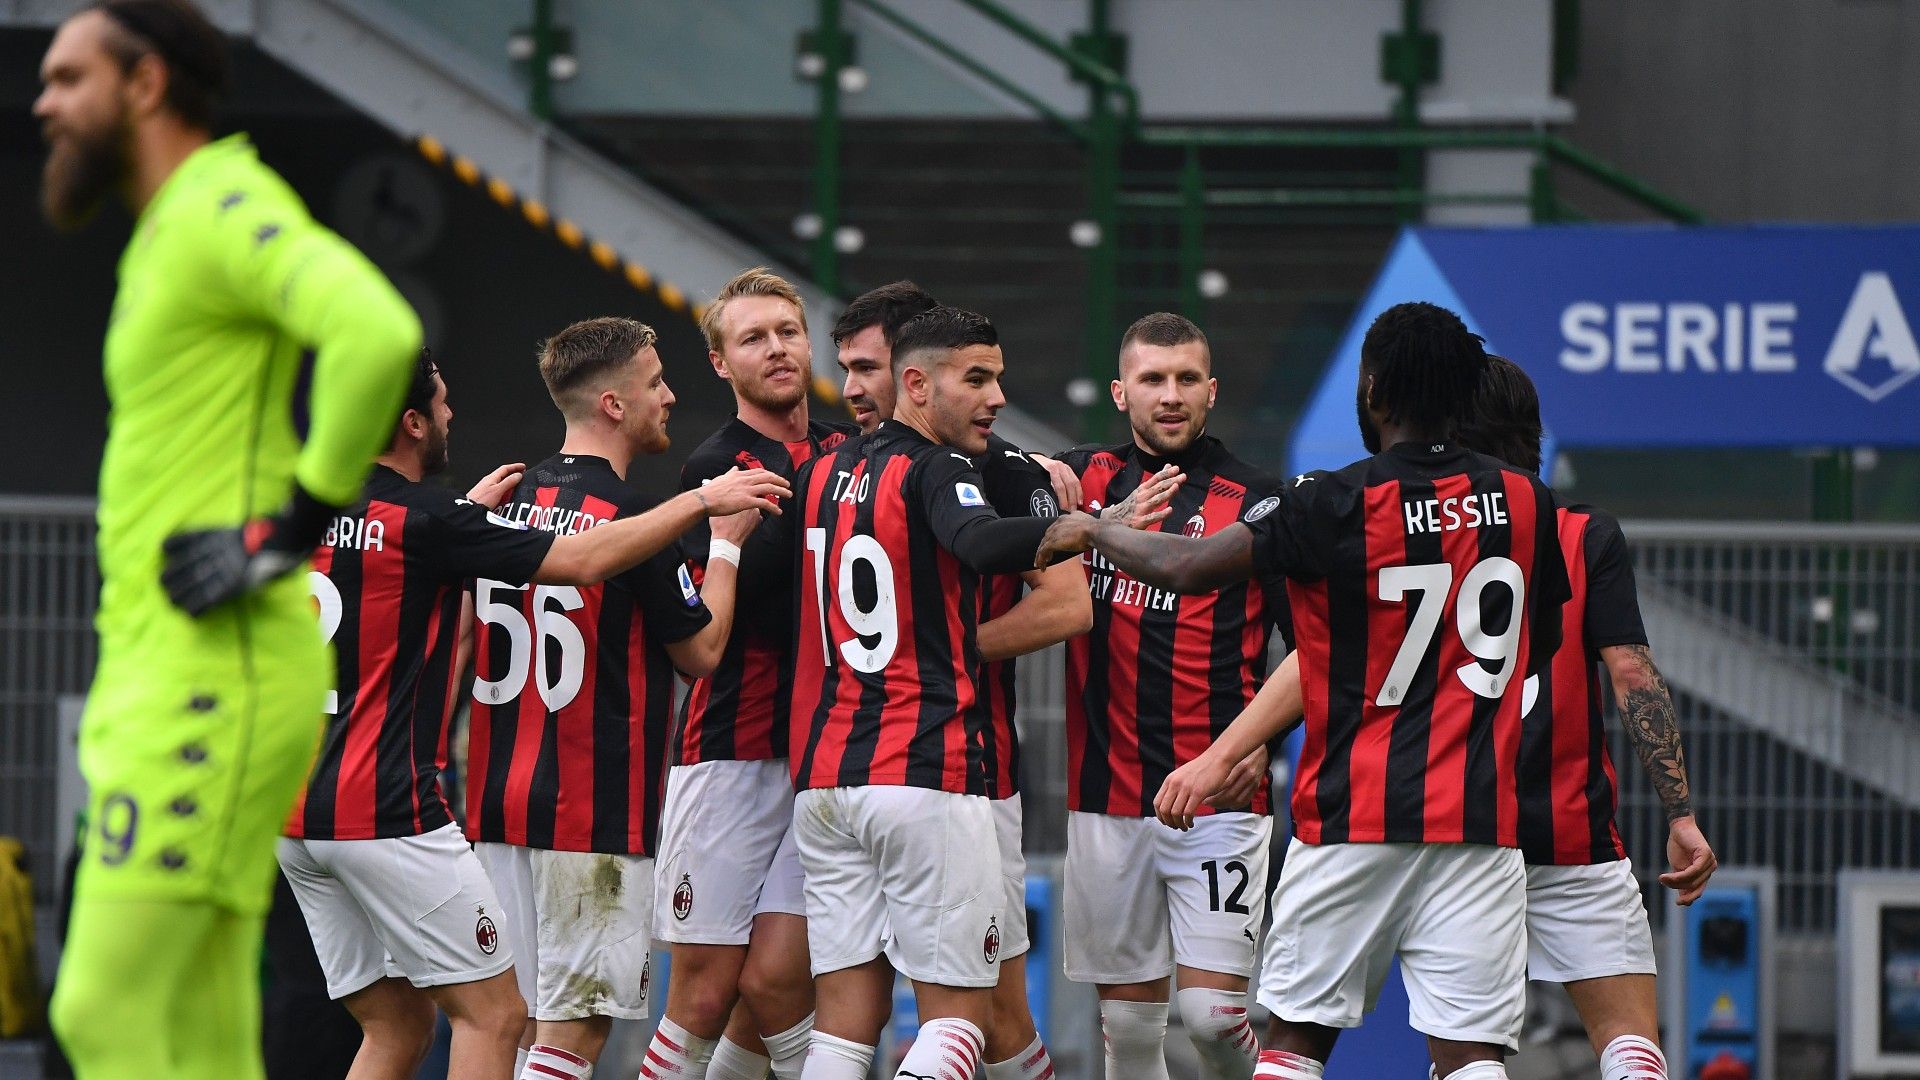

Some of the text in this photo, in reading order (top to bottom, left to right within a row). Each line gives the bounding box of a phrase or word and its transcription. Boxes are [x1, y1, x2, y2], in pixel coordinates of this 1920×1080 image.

[1559, 271, 1920, 400] SERIE A
[321, 516, 385, 552] BRIA
[1404, 492, 1508, 535] KESSIE
[806, 528, 899, 674] 19
[1089, 573, 1113, 600] FLY
[1112, 578, 1176, 612] BETTER
[472, 577, 586, 713] 56
[1375, 556, 1525, 707] 79
[1201, 860, 1250, 915] 12
